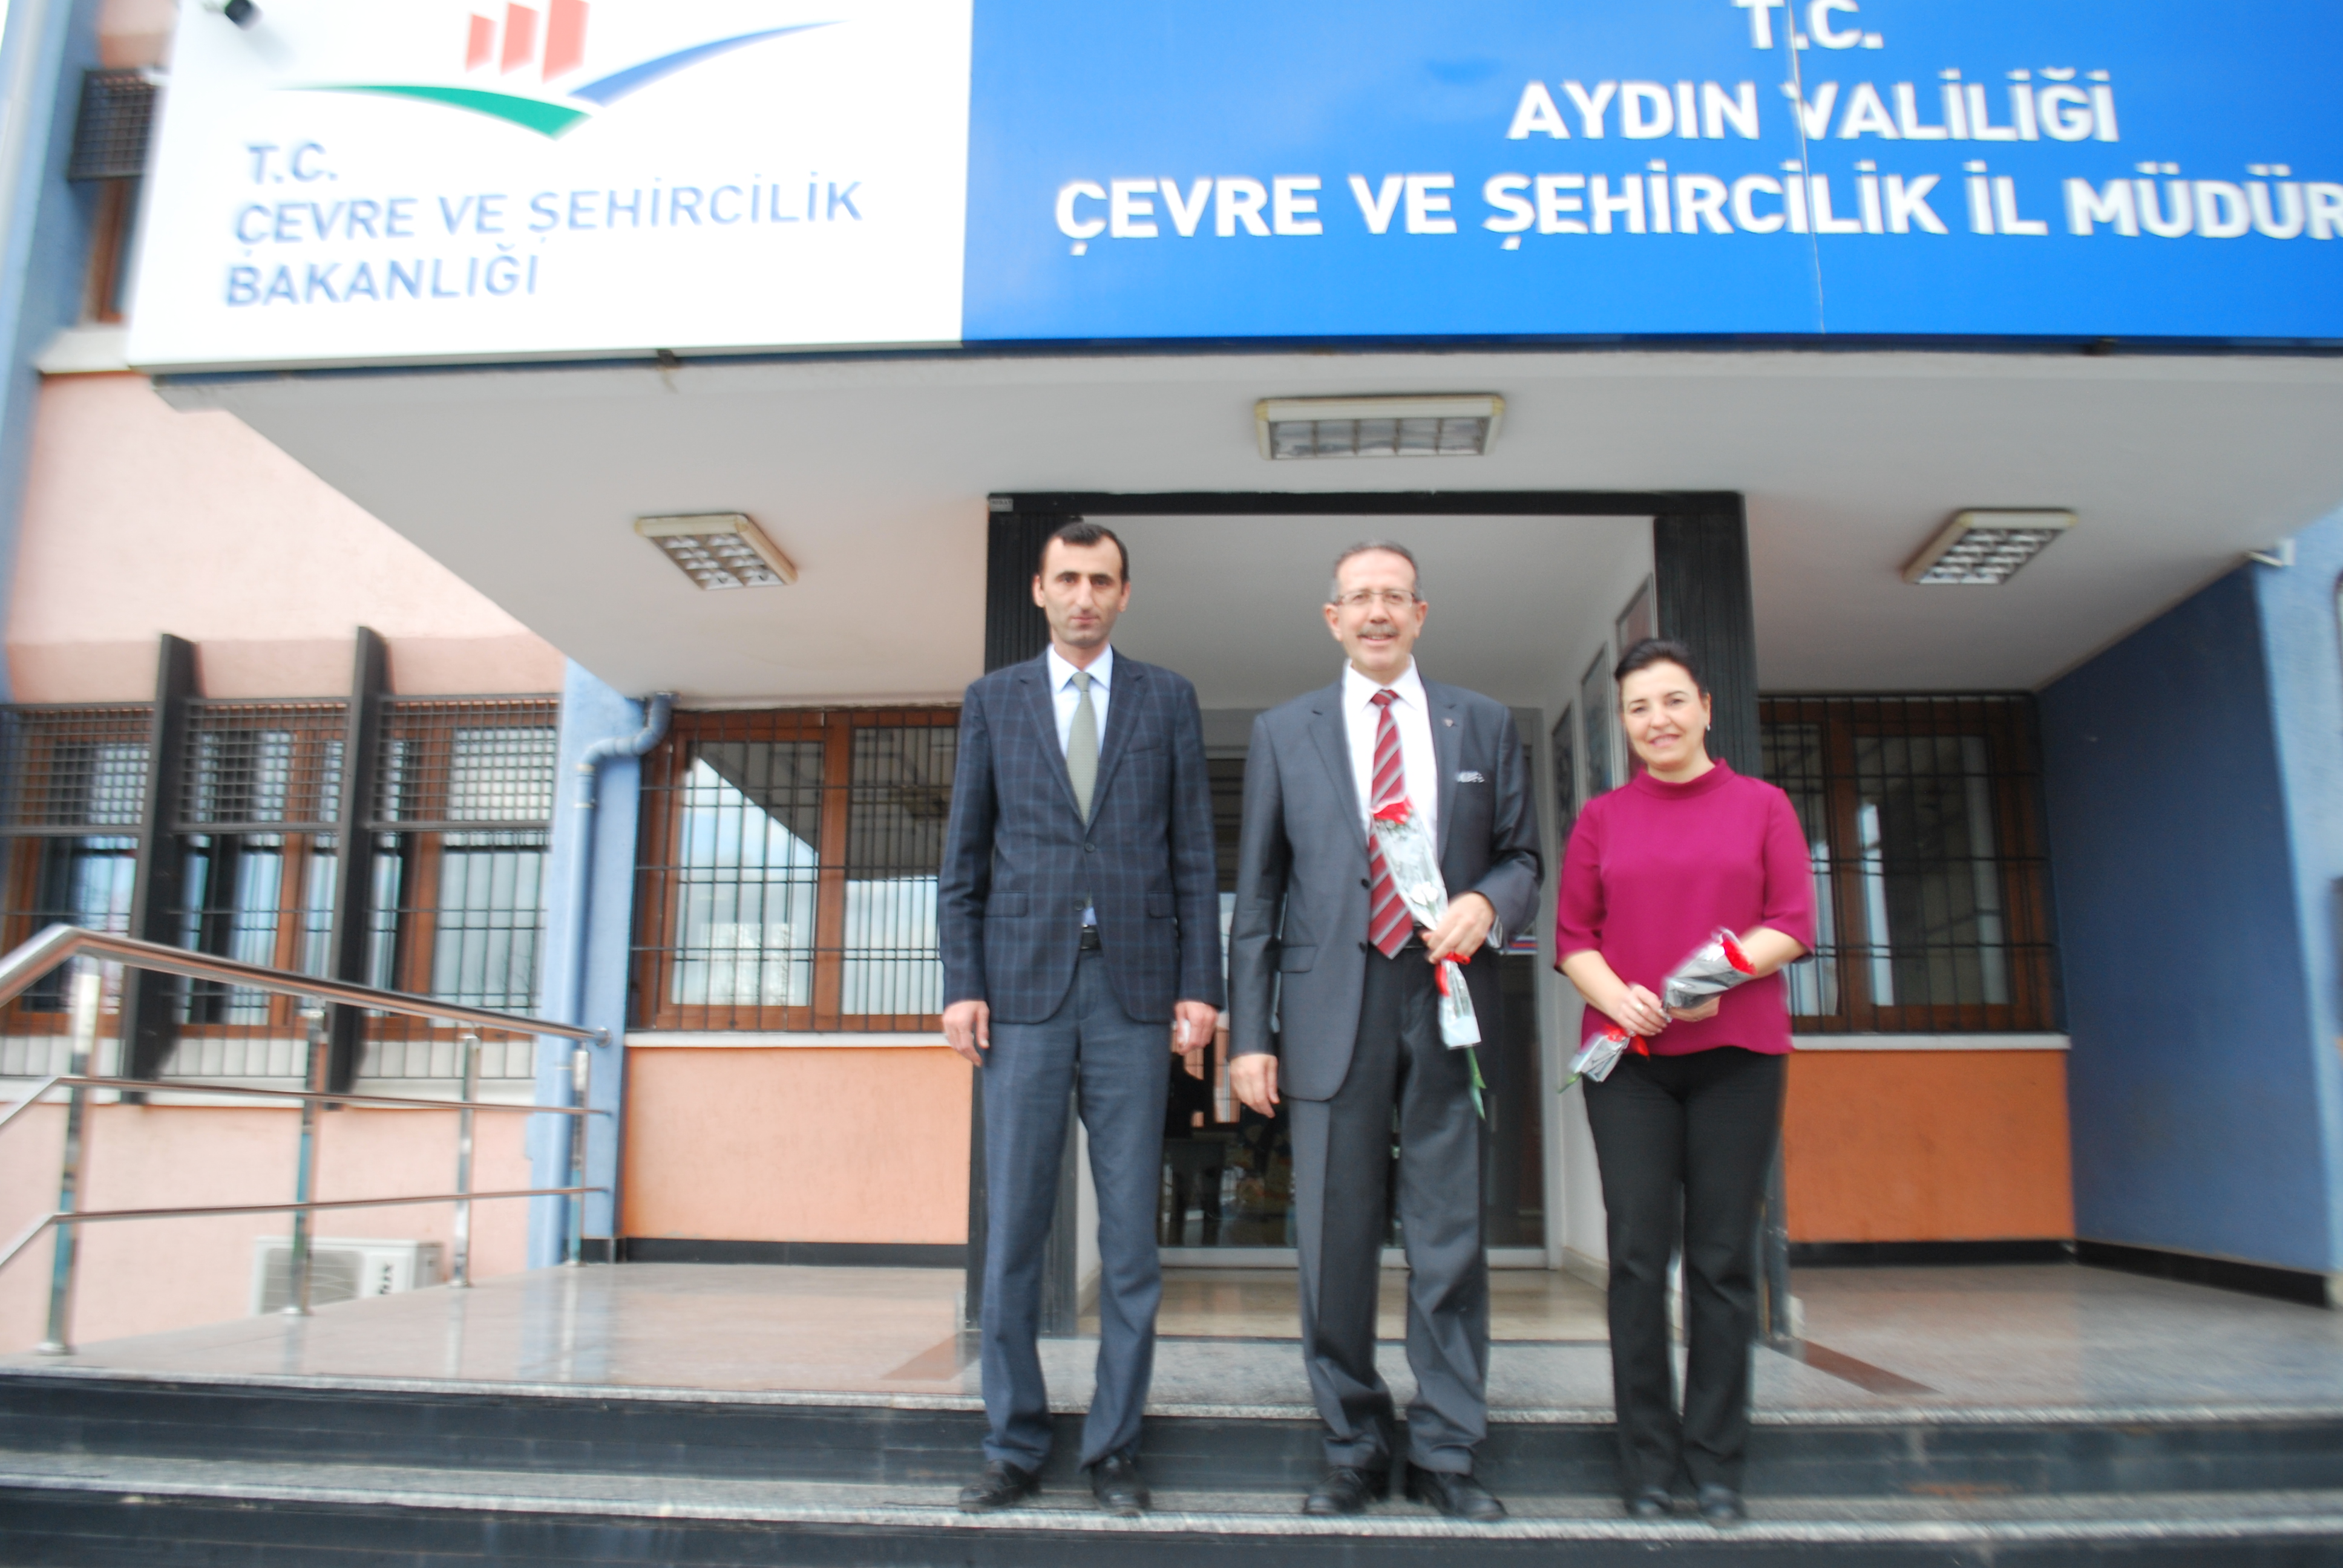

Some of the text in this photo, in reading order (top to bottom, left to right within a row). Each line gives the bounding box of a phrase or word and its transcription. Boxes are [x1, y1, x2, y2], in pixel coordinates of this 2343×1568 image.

[1731, 0, 1884, 50] T.C.
[1506, 67, 2119, 142] AYDIN VALİLİĞİ
[246, 141, 337, 183] T.C.
[234, 172, 862, 256] ÇEVRE VE ŞEHİRCİLİK
[1052, 174, 1323, 256] ÇEVRE
[1346, 172, 1458, 235] VE
[1482, 159, 1949, 250] ŞEHİRCİLİK
[1965, 160, 2049, 235] İL
[224, 243, 537, 307] BAKANLIĞI
